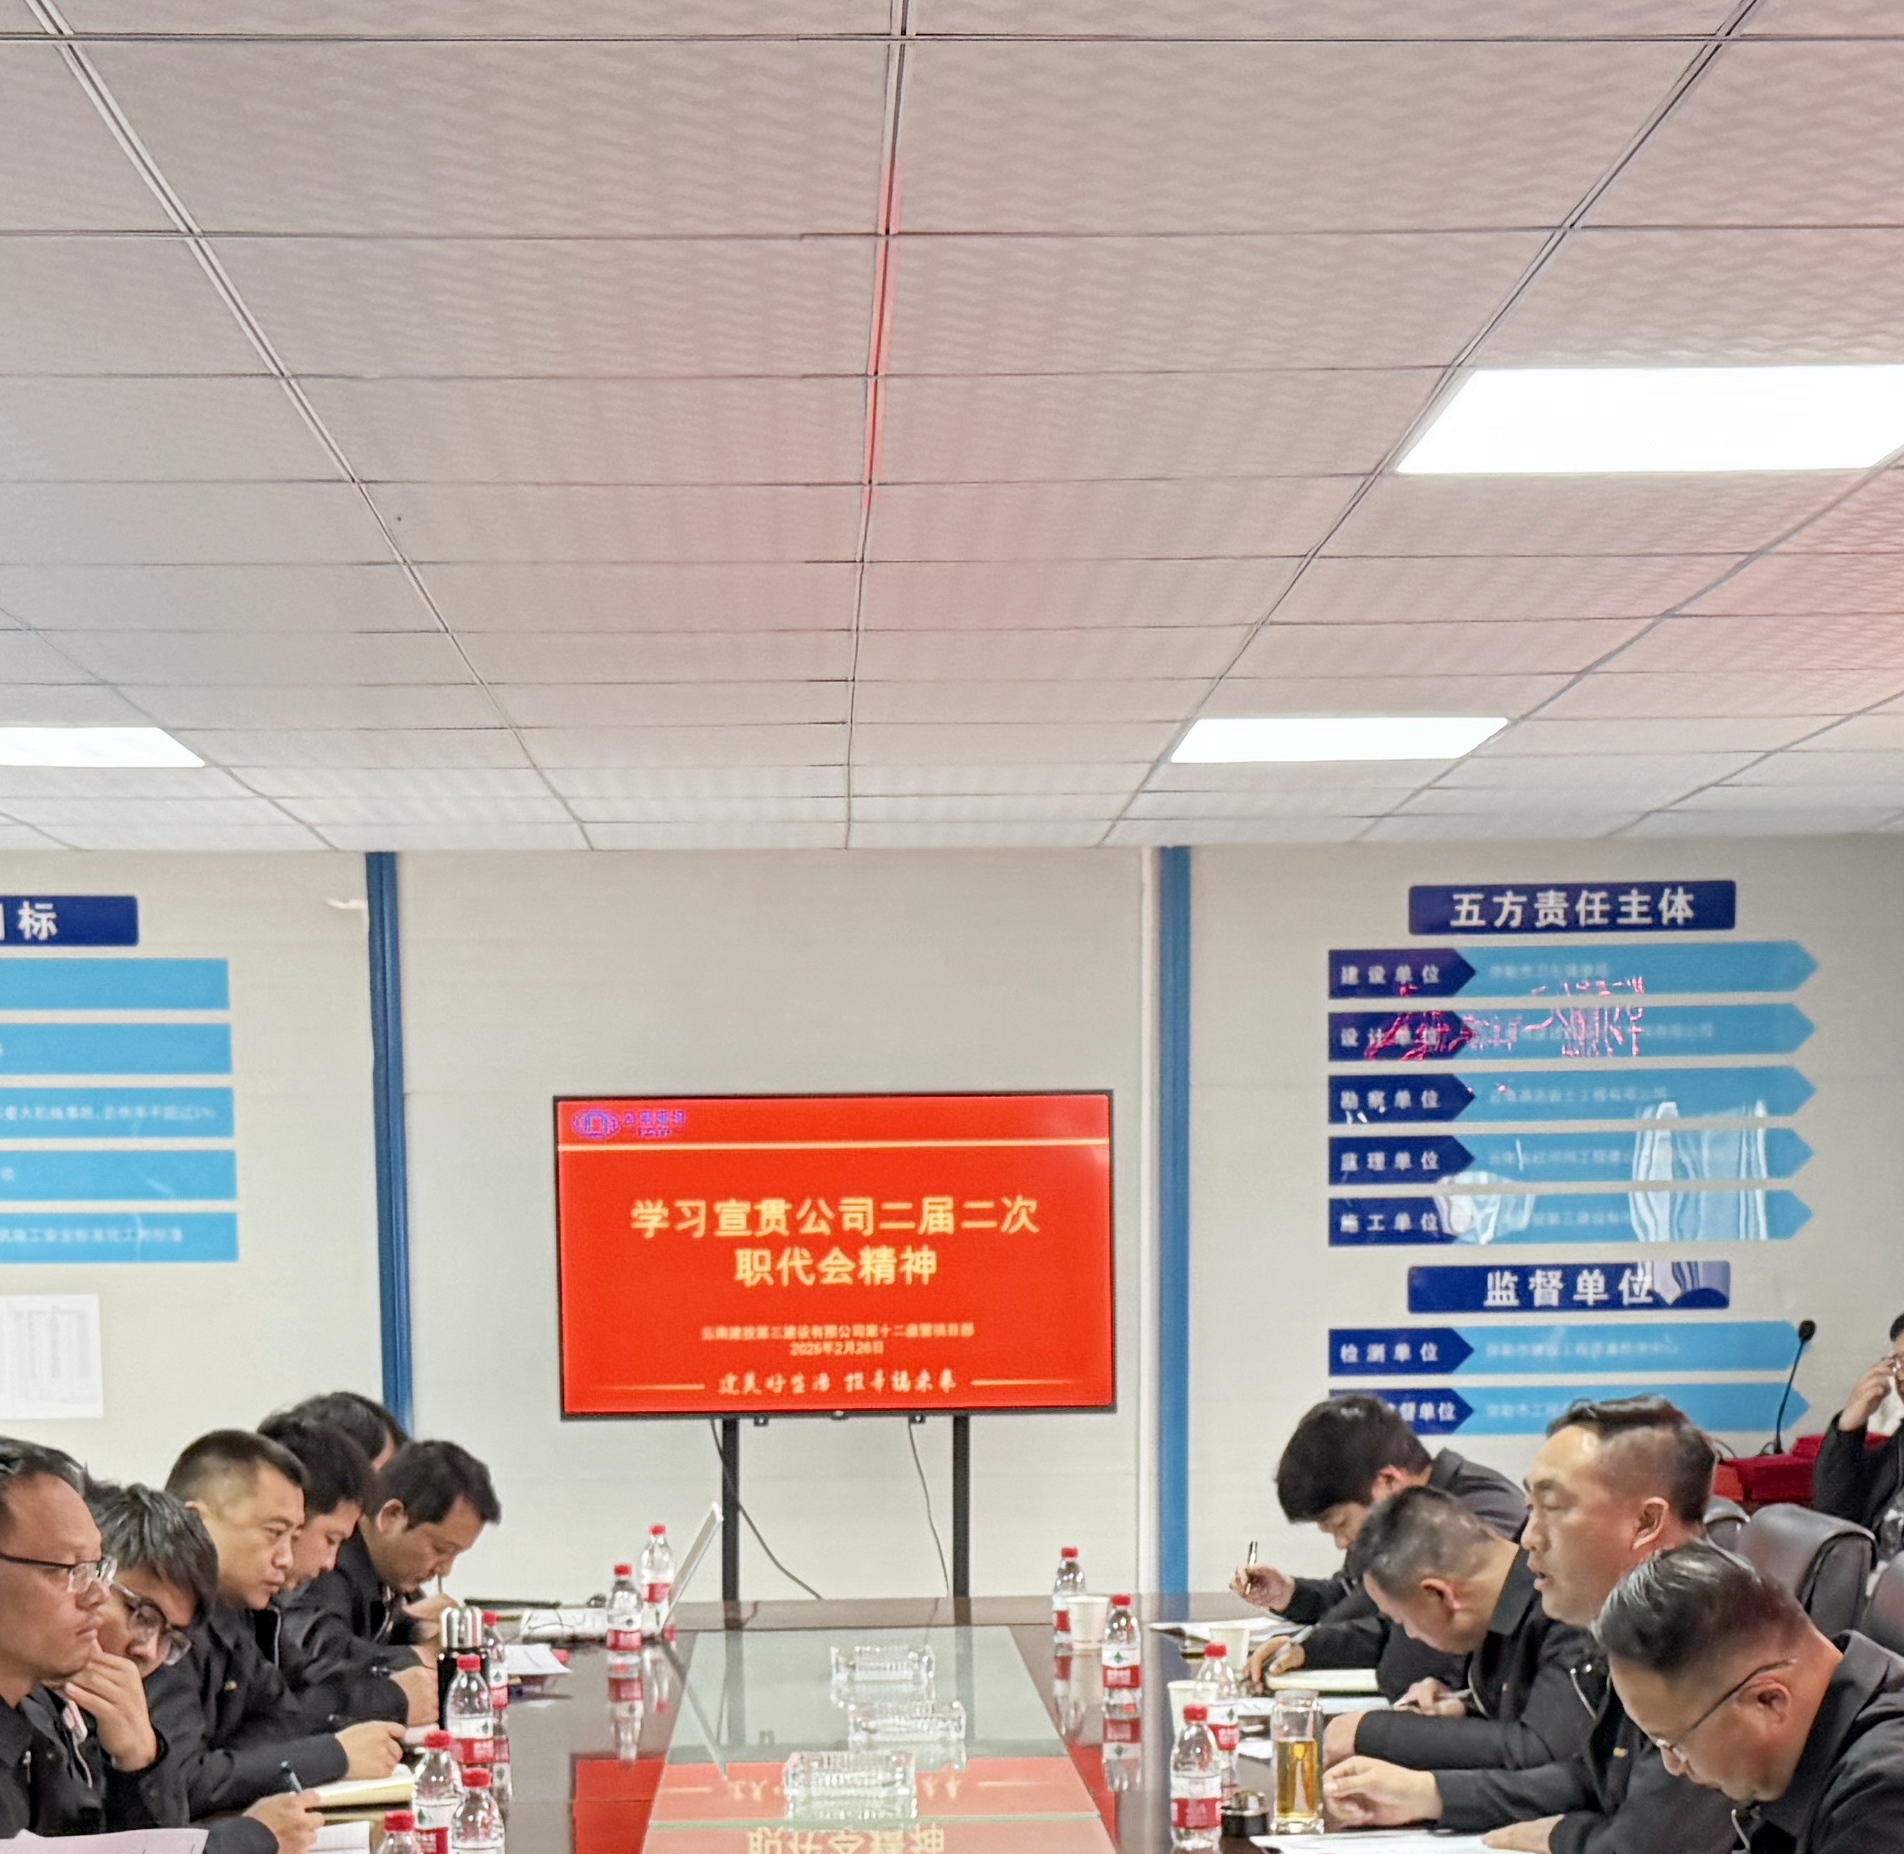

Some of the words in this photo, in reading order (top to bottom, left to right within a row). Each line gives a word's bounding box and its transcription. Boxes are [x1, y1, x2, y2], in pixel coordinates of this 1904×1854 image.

[1450, 889, 1694, 928] 五方责任主体
[1340, 965, 1441, 985] 建设单位
[1340, 1152, 1440, 1172] 监理单位
[630, 1195, 1039, 1238] 学习宣贯公司二届二次
[734, 1245, 938, 1287] 职代会精神
[1483, 1268, 1656, 1308] 监督单位
[1340, 1342, 1439, 1365] 检测单位
[1390, 1402, 1456, 1422] 督单位
